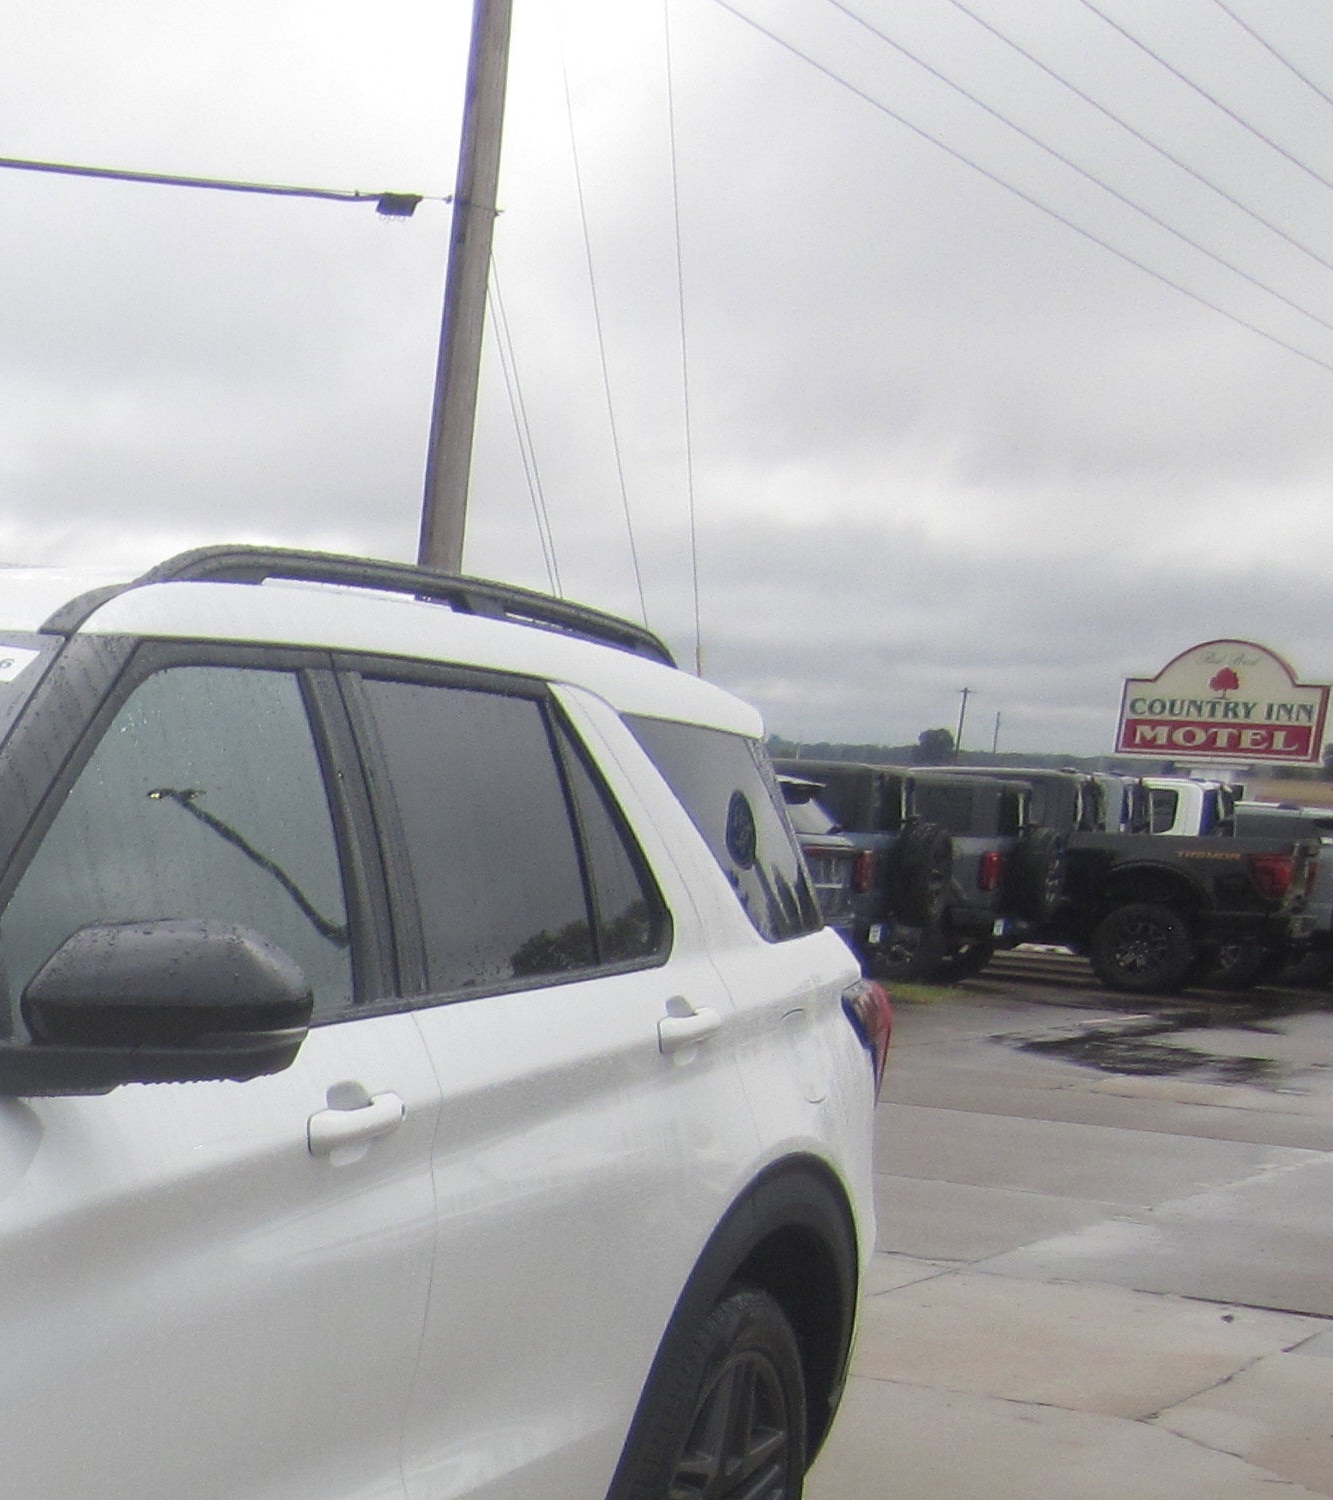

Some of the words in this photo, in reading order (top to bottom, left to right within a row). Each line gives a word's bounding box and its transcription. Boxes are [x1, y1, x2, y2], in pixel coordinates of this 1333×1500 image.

[1129, 698, 1258, 720] COUNTRY
[1265, 702, 1314, 723] INN
[1135, 725, 1299, 751] MOTEL
